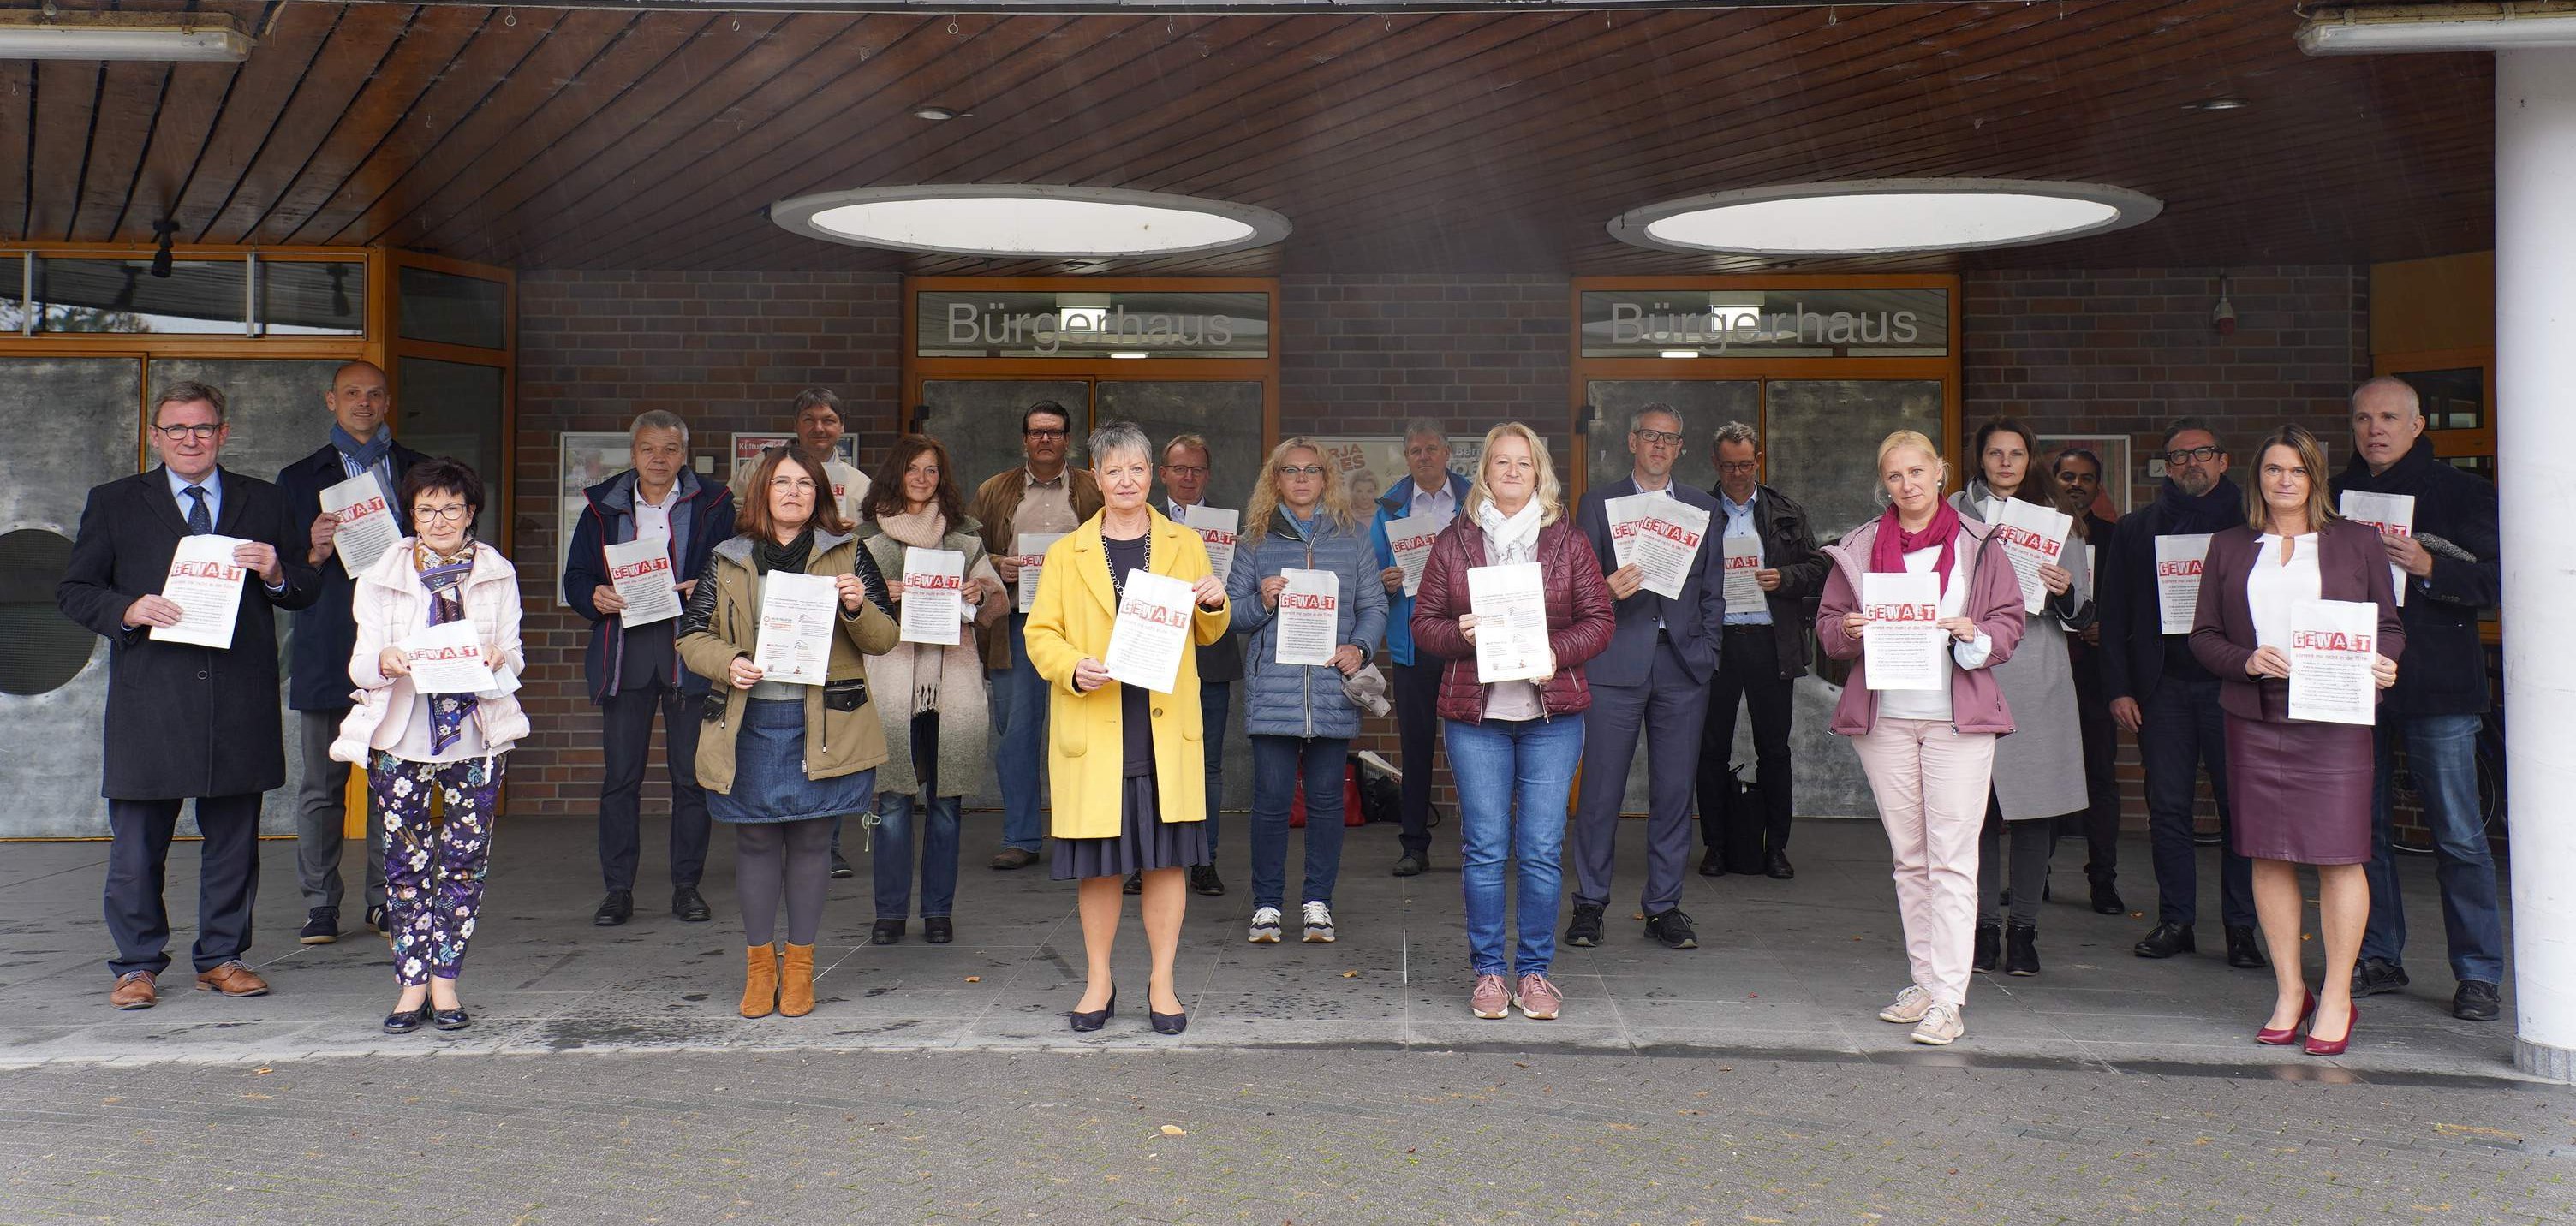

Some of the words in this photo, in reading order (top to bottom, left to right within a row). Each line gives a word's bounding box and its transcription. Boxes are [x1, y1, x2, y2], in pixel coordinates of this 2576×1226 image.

[947, 302, 1233, 355] Bürgerhaus
[1612, 302, 1919, 355] Bürgerhaus
[1642, 516, 1700, 547] GEWALT
[1392, 533, 1436, 552] GEWALT
[171, 561, 242, 581] GEWALT
[611, 557, 669, 580] GEWALT
[904, 573, 961, 589] GEWALT
[1280, 592, 1335, 610] GEWALT
[1121, 598, 1188, 629] GEWALT
[1865, 604, 1935, 622] GEWALT
[2293, 630, 2371, 652] GEWALT
[407, 645, 480, 660] GEWALT
